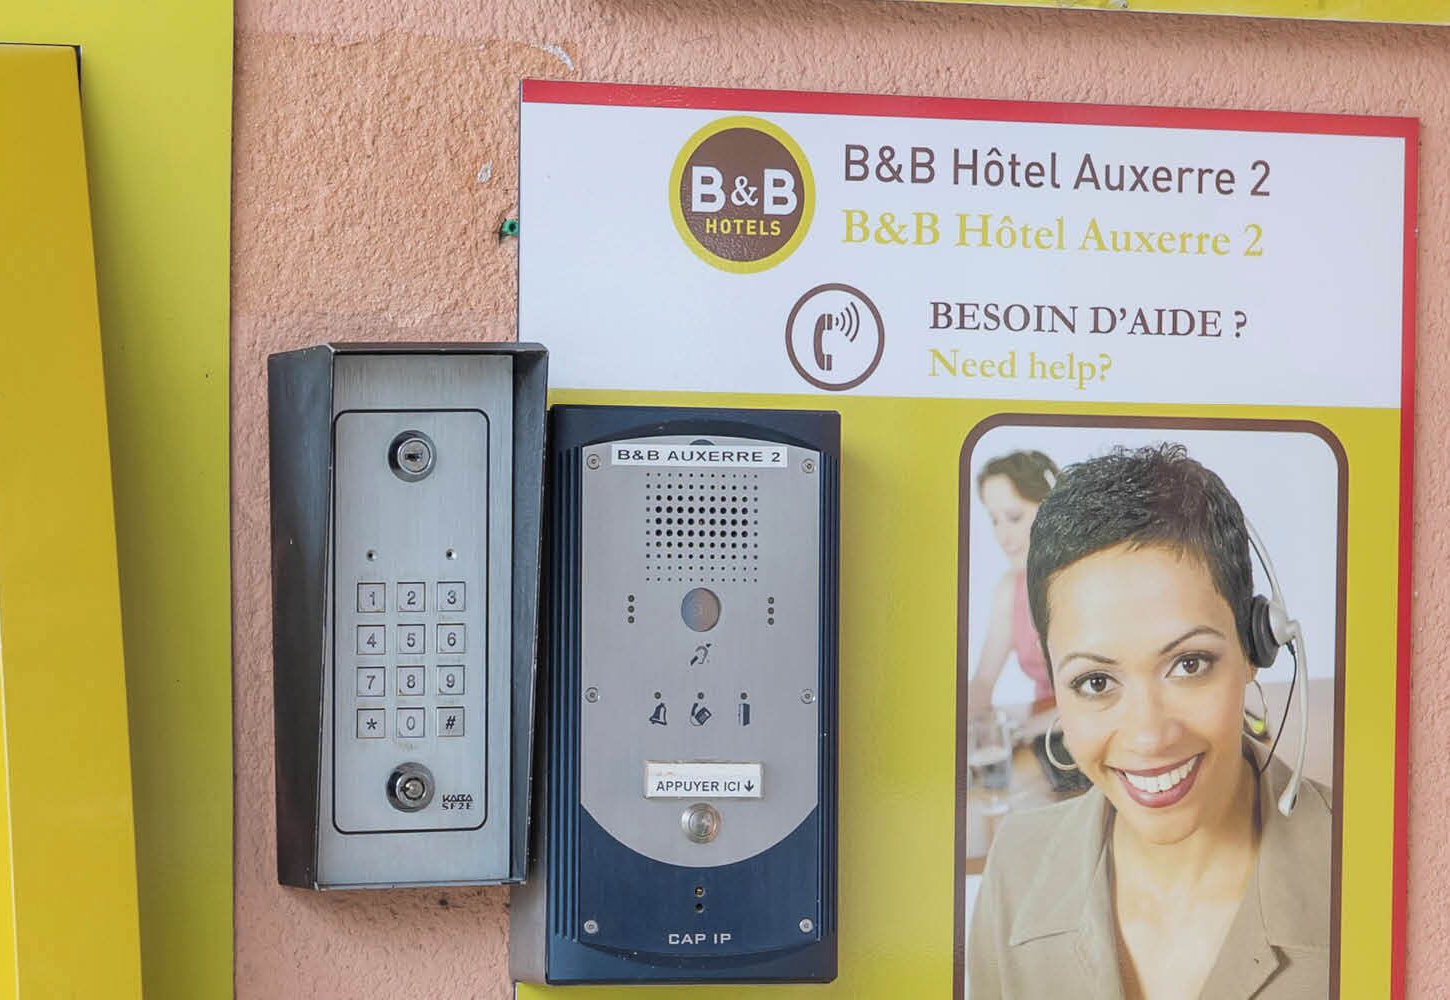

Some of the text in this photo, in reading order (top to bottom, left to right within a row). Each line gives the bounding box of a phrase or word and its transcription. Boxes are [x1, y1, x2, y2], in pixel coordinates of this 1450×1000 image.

[844, 144, 1272, 197] B&B Hôtel Auxerre 2
[691, 164, 799, 216] B&B
[705, 217, 782, 238] HOTELS
[841, 209, 1264, 258] B&B Hôtel Auxerre 2
[930, 300, 1248, 338] BESOIN D'AIDE ?
[928, 349, 1113, 390] Need help?
[617, 449, 781, 463] B&B AUXERRE 2
[369, 590, 457, 606] 1 2 3
[366, 632, 456, 648] 4 5 6
[366, 674, 455, 690] 7 8 9
[406, 716, 416, 731] 0
[445, 715, 456, 730] #
[656, 780, 740, 792] APPUYER ICI
[668, 933, 732, 945] CAP IP
